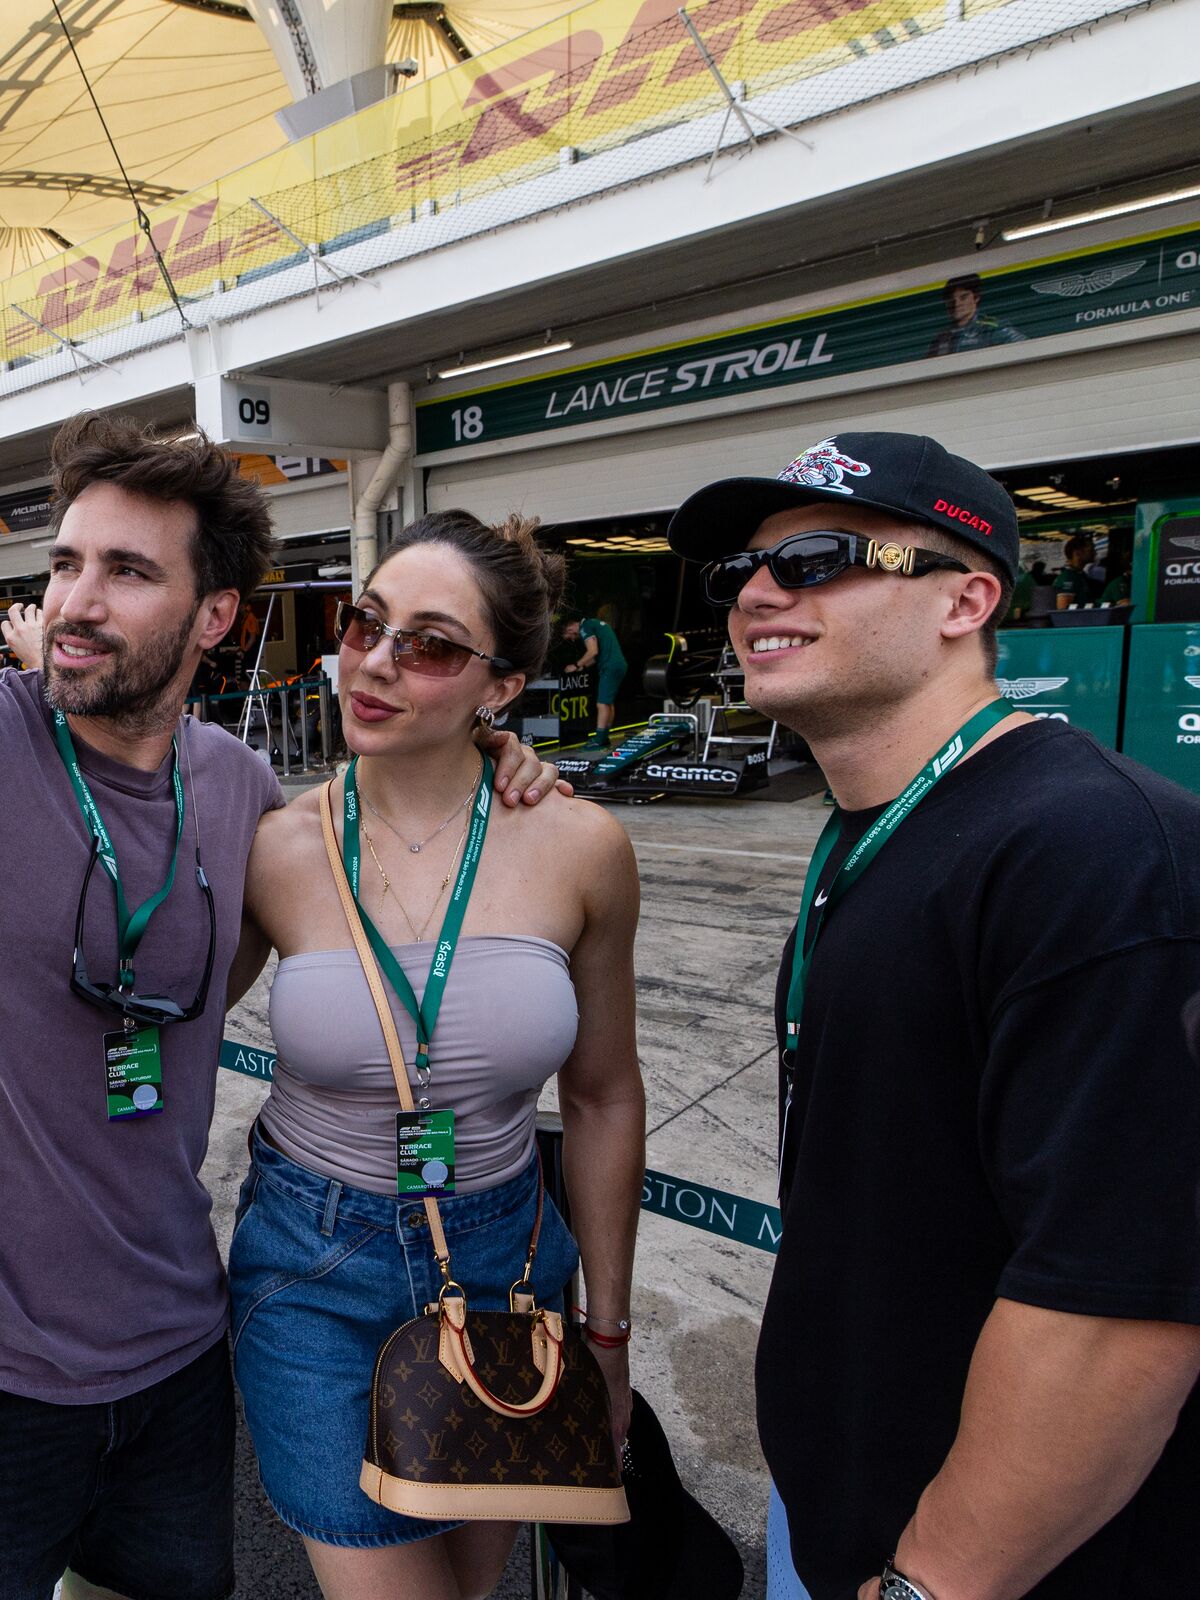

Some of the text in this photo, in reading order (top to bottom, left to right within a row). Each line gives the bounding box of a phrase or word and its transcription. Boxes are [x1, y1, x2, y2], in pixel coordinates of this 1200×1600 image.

[36, 198, 234, 335] DHL
[1075, 292, 1191, 323] FORMULA ONE
[451, 332, 834, 442] 18 LANCE STROLL
[239, 398, 270, 425] 09
[11, 502, 50, 517] McLaren
[933, 498, 993, 536] DUCATI
[560, 673, 589, 691] LANCE
[560, 696, 589, 721] STR
[747, 752, 766, 765] BOSS
[646, 764, 738, 783] aramco
[903, 777, 926, 798] Grande
[878, 818, 887, 827] de
[886, 807, 908, 830] Lenovo
[856, 837, 872, 856] Paulo
[844, 855, 859, 871] 2024
[454, 886, 462, 901] 2024
[108, 1062, 139, 1072] TERRACE
[108, 1070, 126, 1078] CLUB
[641, 1175, 737, 1231] STON
